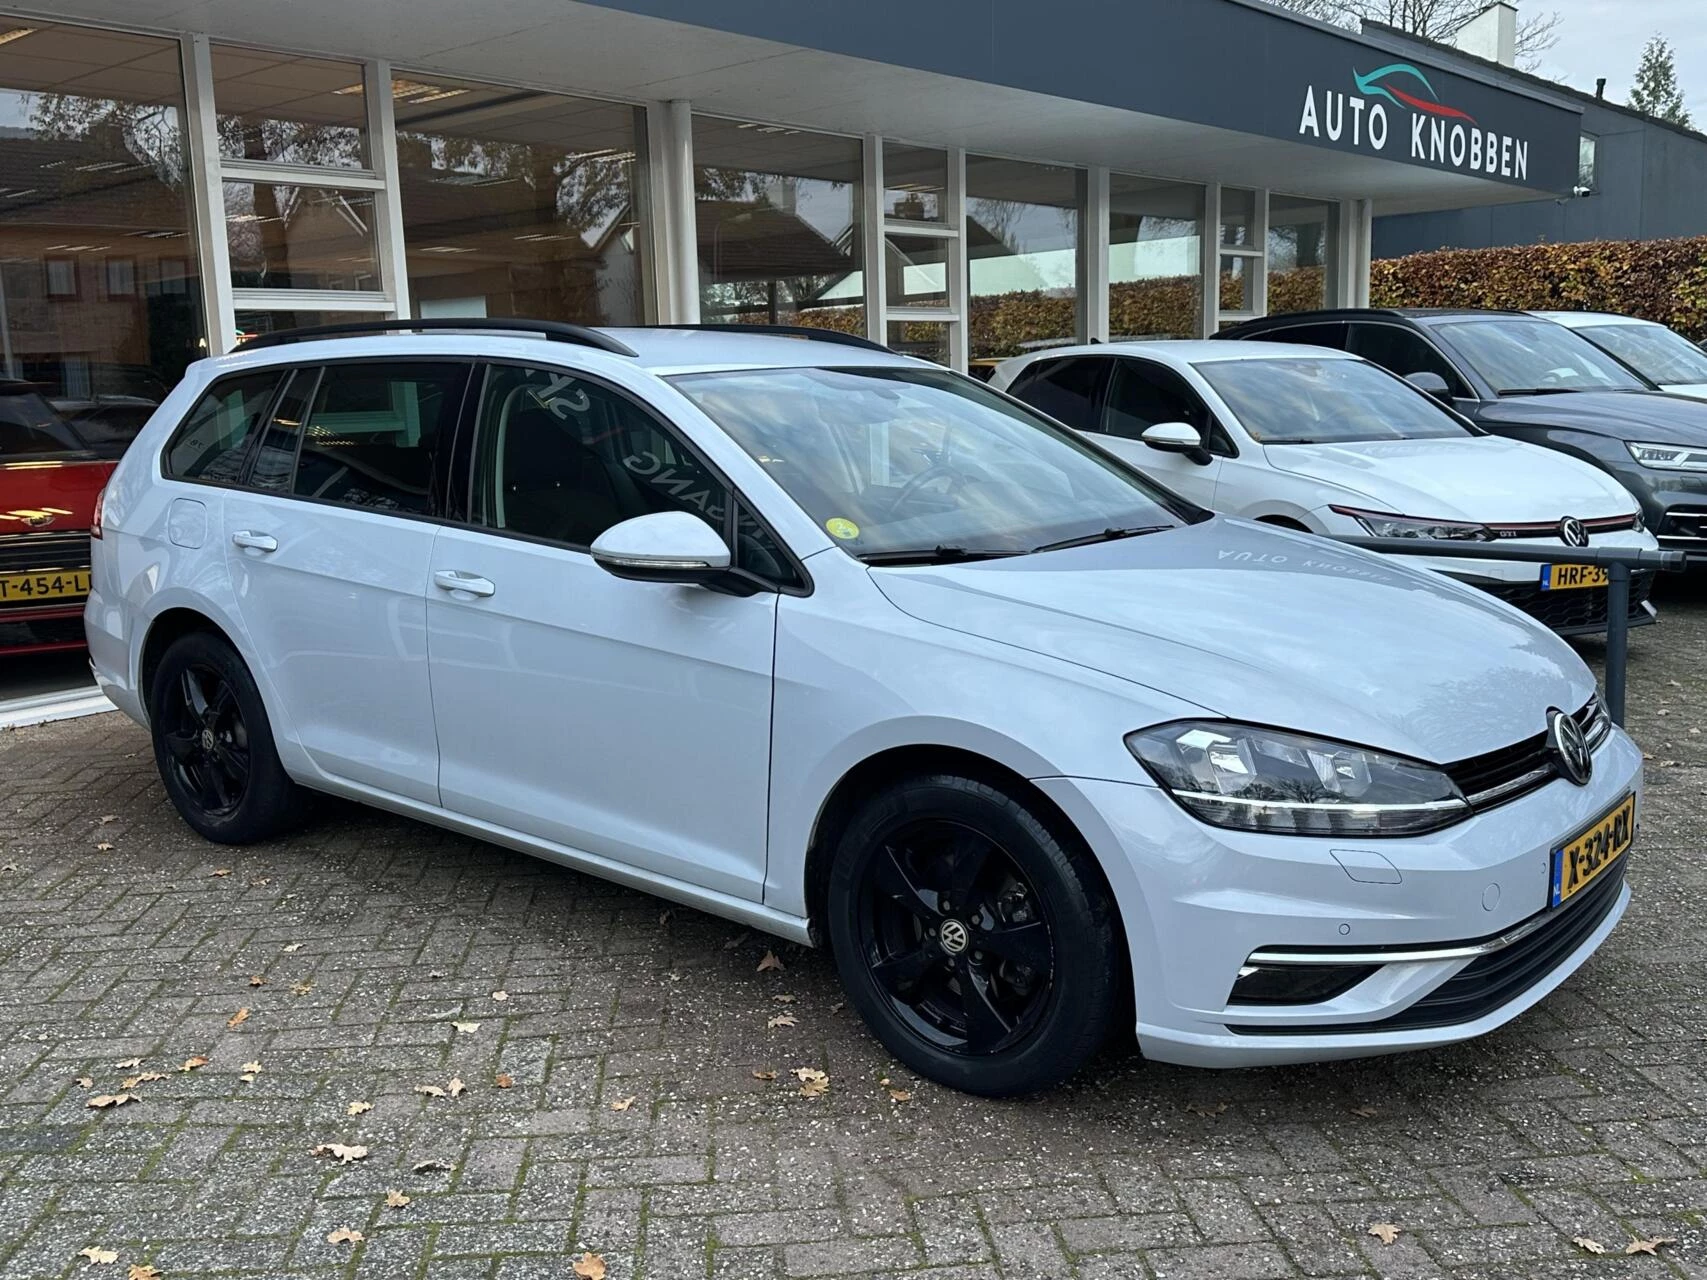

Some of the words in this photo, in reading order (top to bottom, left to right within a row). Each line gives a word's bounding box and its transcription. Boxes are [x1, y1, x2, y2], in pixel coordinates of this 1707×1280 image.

[1299, 85, 1388, 150] AUTO
[1411, 112, 1529, 181] KNOBBEN
[1567, 805, 1631, 890] X-324-RX
